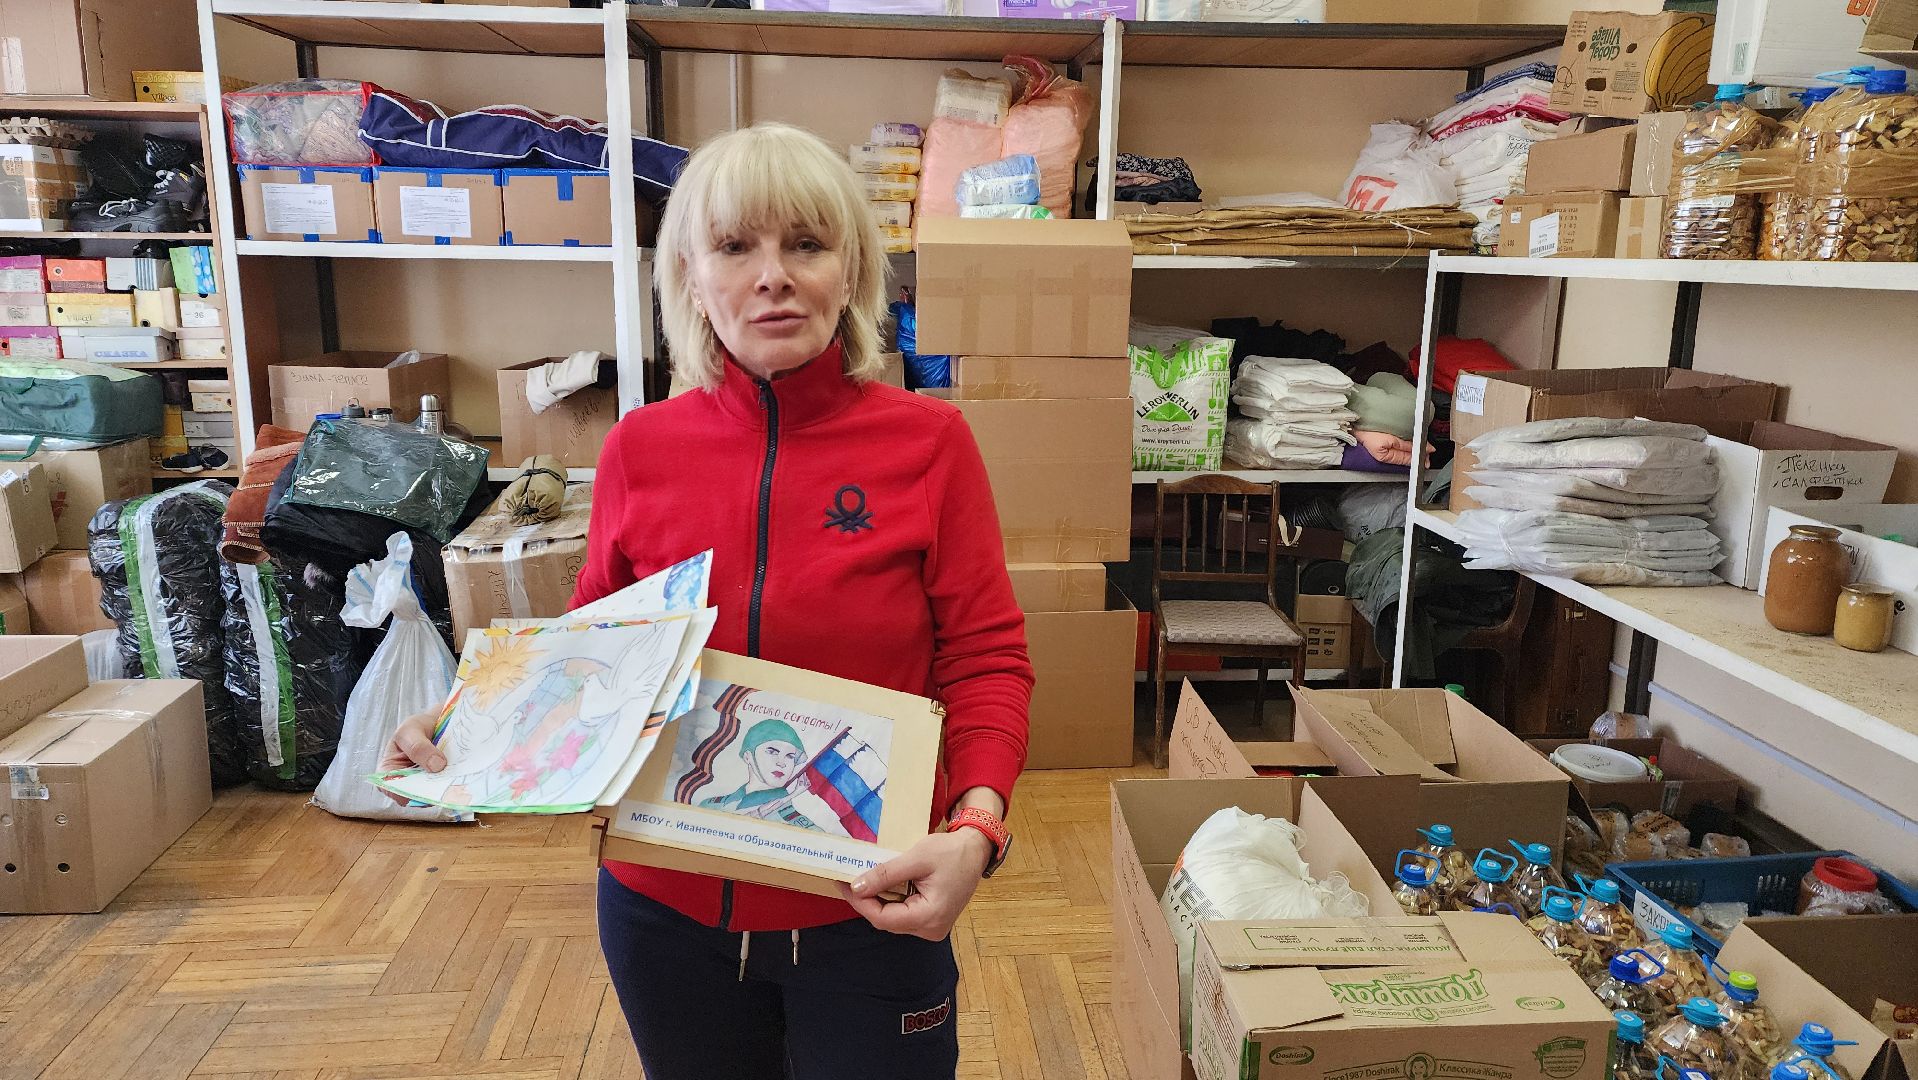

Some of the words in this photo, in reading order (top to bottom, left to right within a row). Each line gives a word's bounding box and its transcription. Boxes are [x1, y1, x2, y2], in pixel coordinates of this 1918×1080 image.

[1591, 26, 1621, 45] Village
[1589, 45, 1621, 61] Global
[1135, 392, 1167, 418] LEROY
[631, 812, 664, 825] МБОУ
[738, 833, 833, 860] «Образовательный
[836, 855, 863, 867] центр
[1330, 968, 1489, 1007] Доширак
[902, 1000, 949, 1034] BOSCO
[1365, 1067, 1400, 1077] Doshirak
